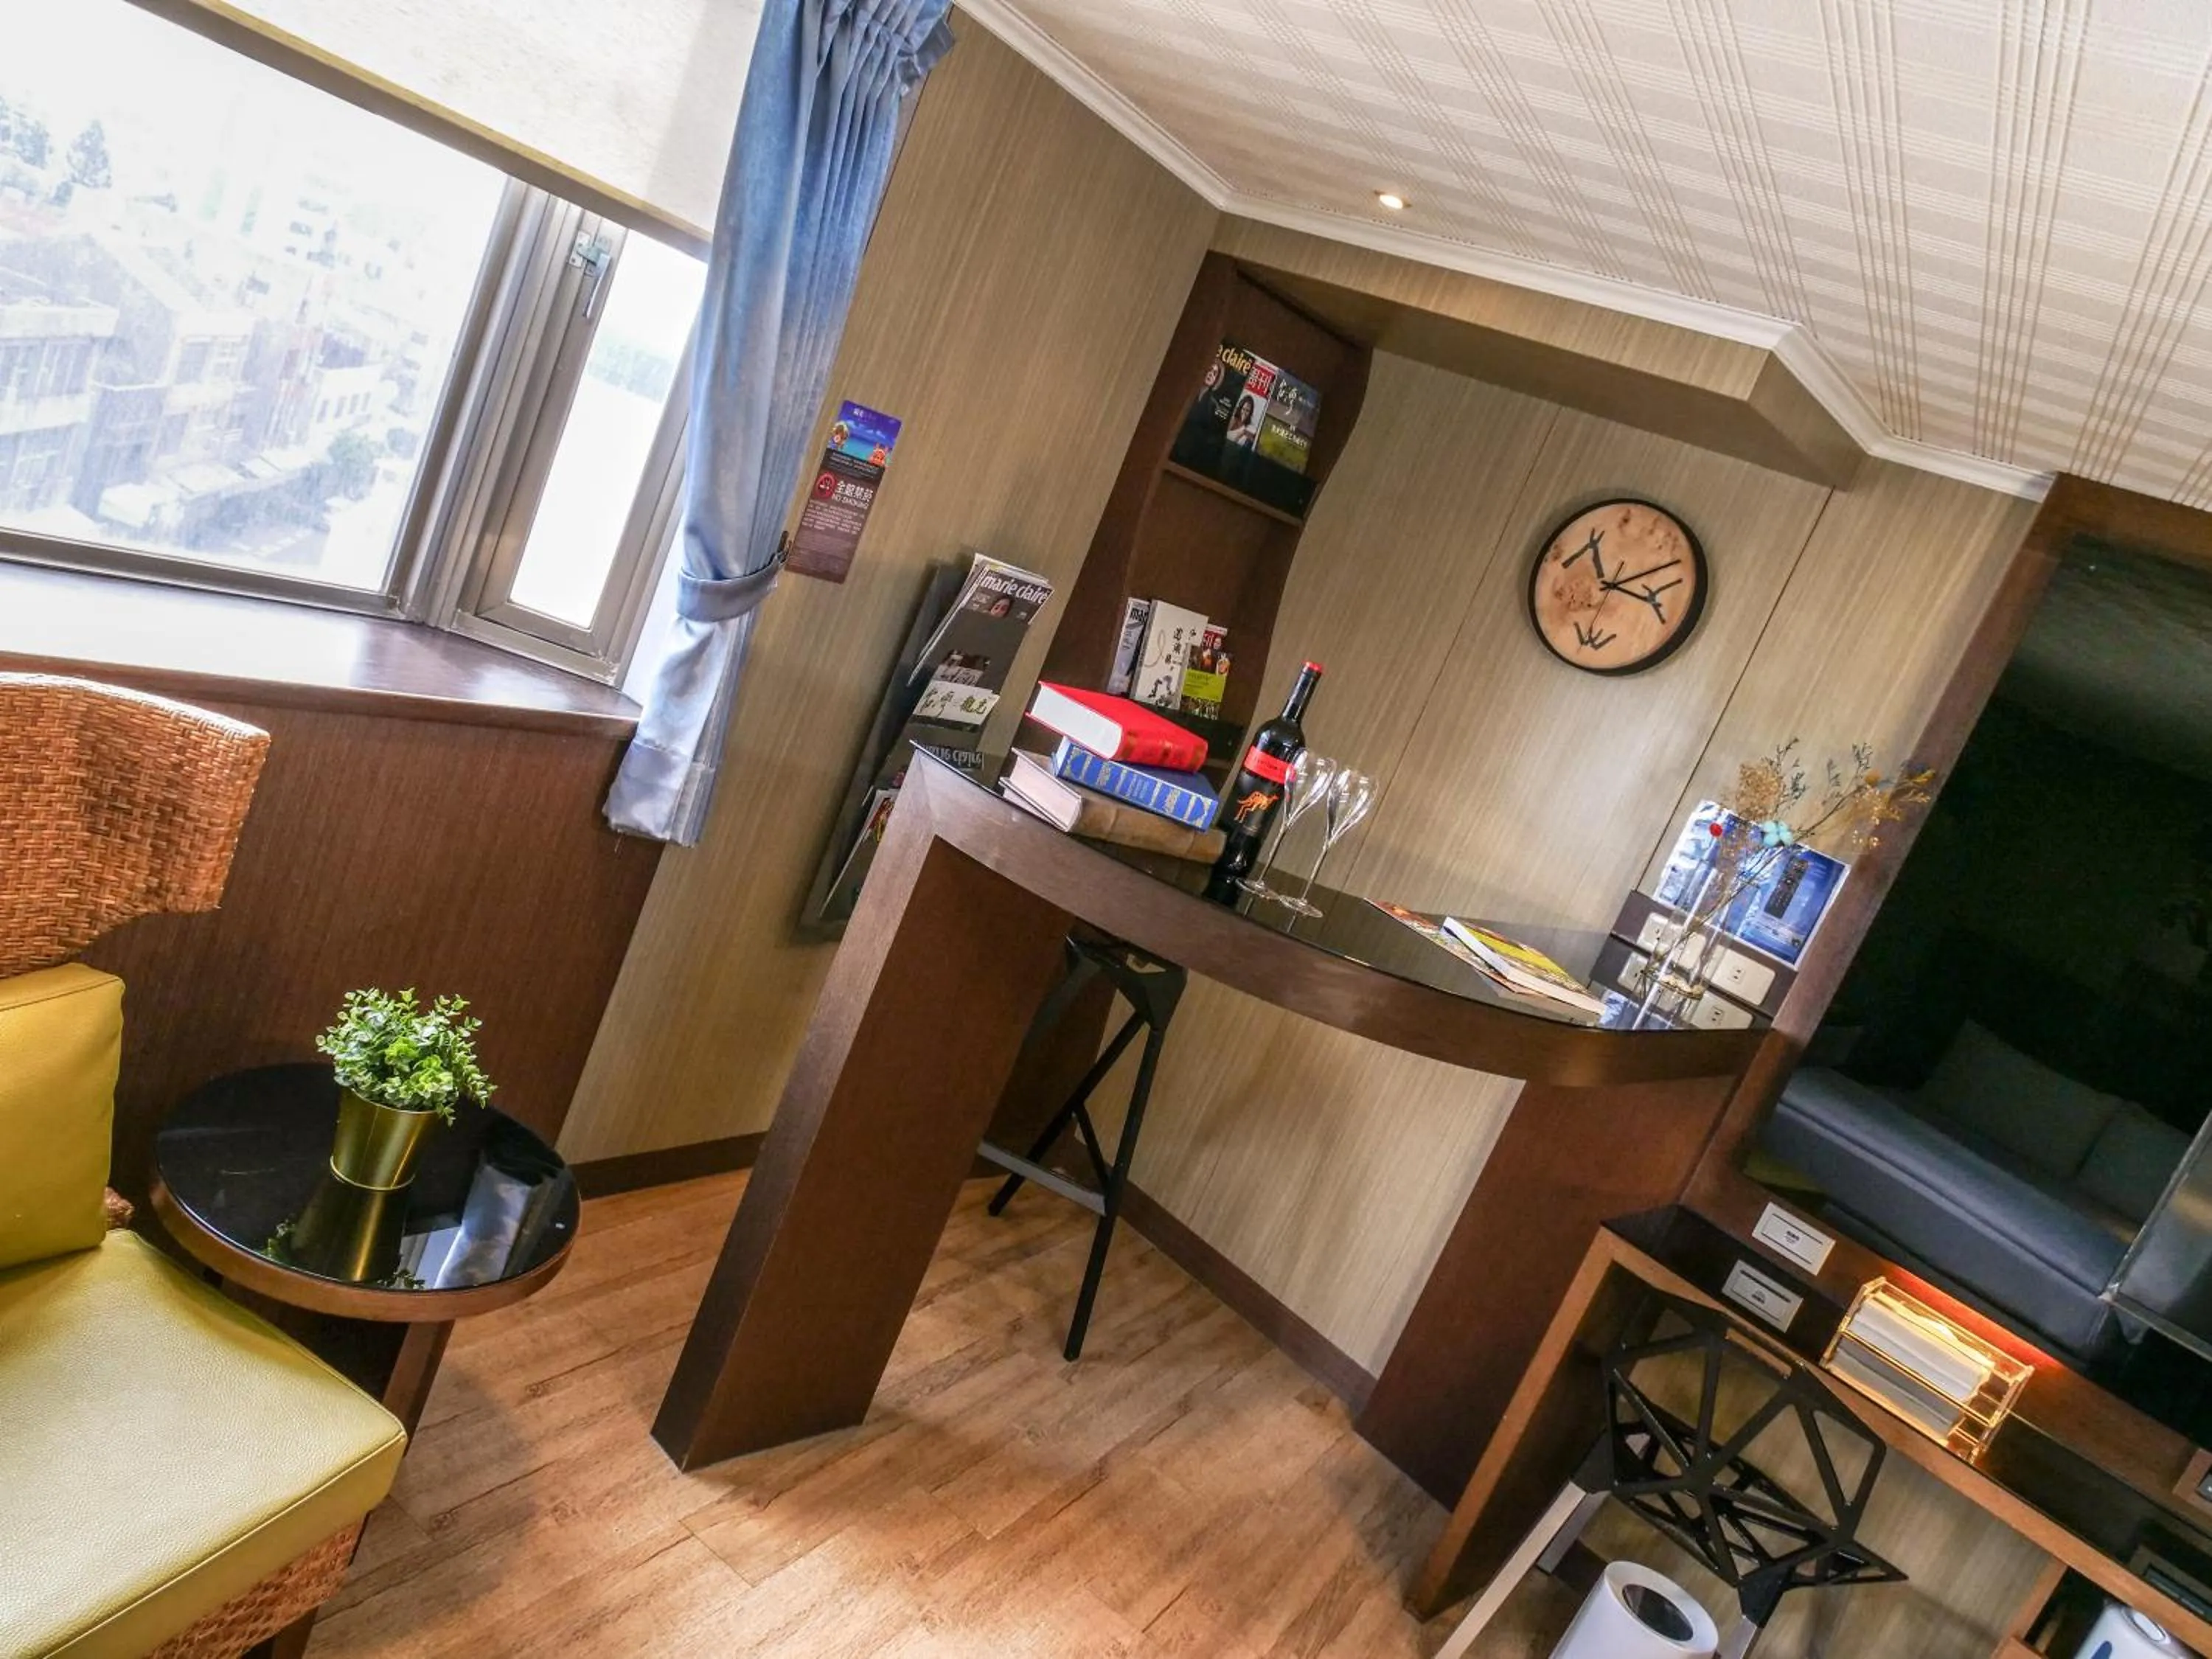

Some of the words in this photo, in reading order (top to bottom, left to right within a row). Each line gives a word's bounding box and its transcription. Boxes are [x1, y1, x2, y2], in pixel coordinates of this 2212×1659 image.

[1222, 347, 1251, 375] claire
[981, 574, 1018, 595] marie
[1015, 584, 1048, 604] claire
